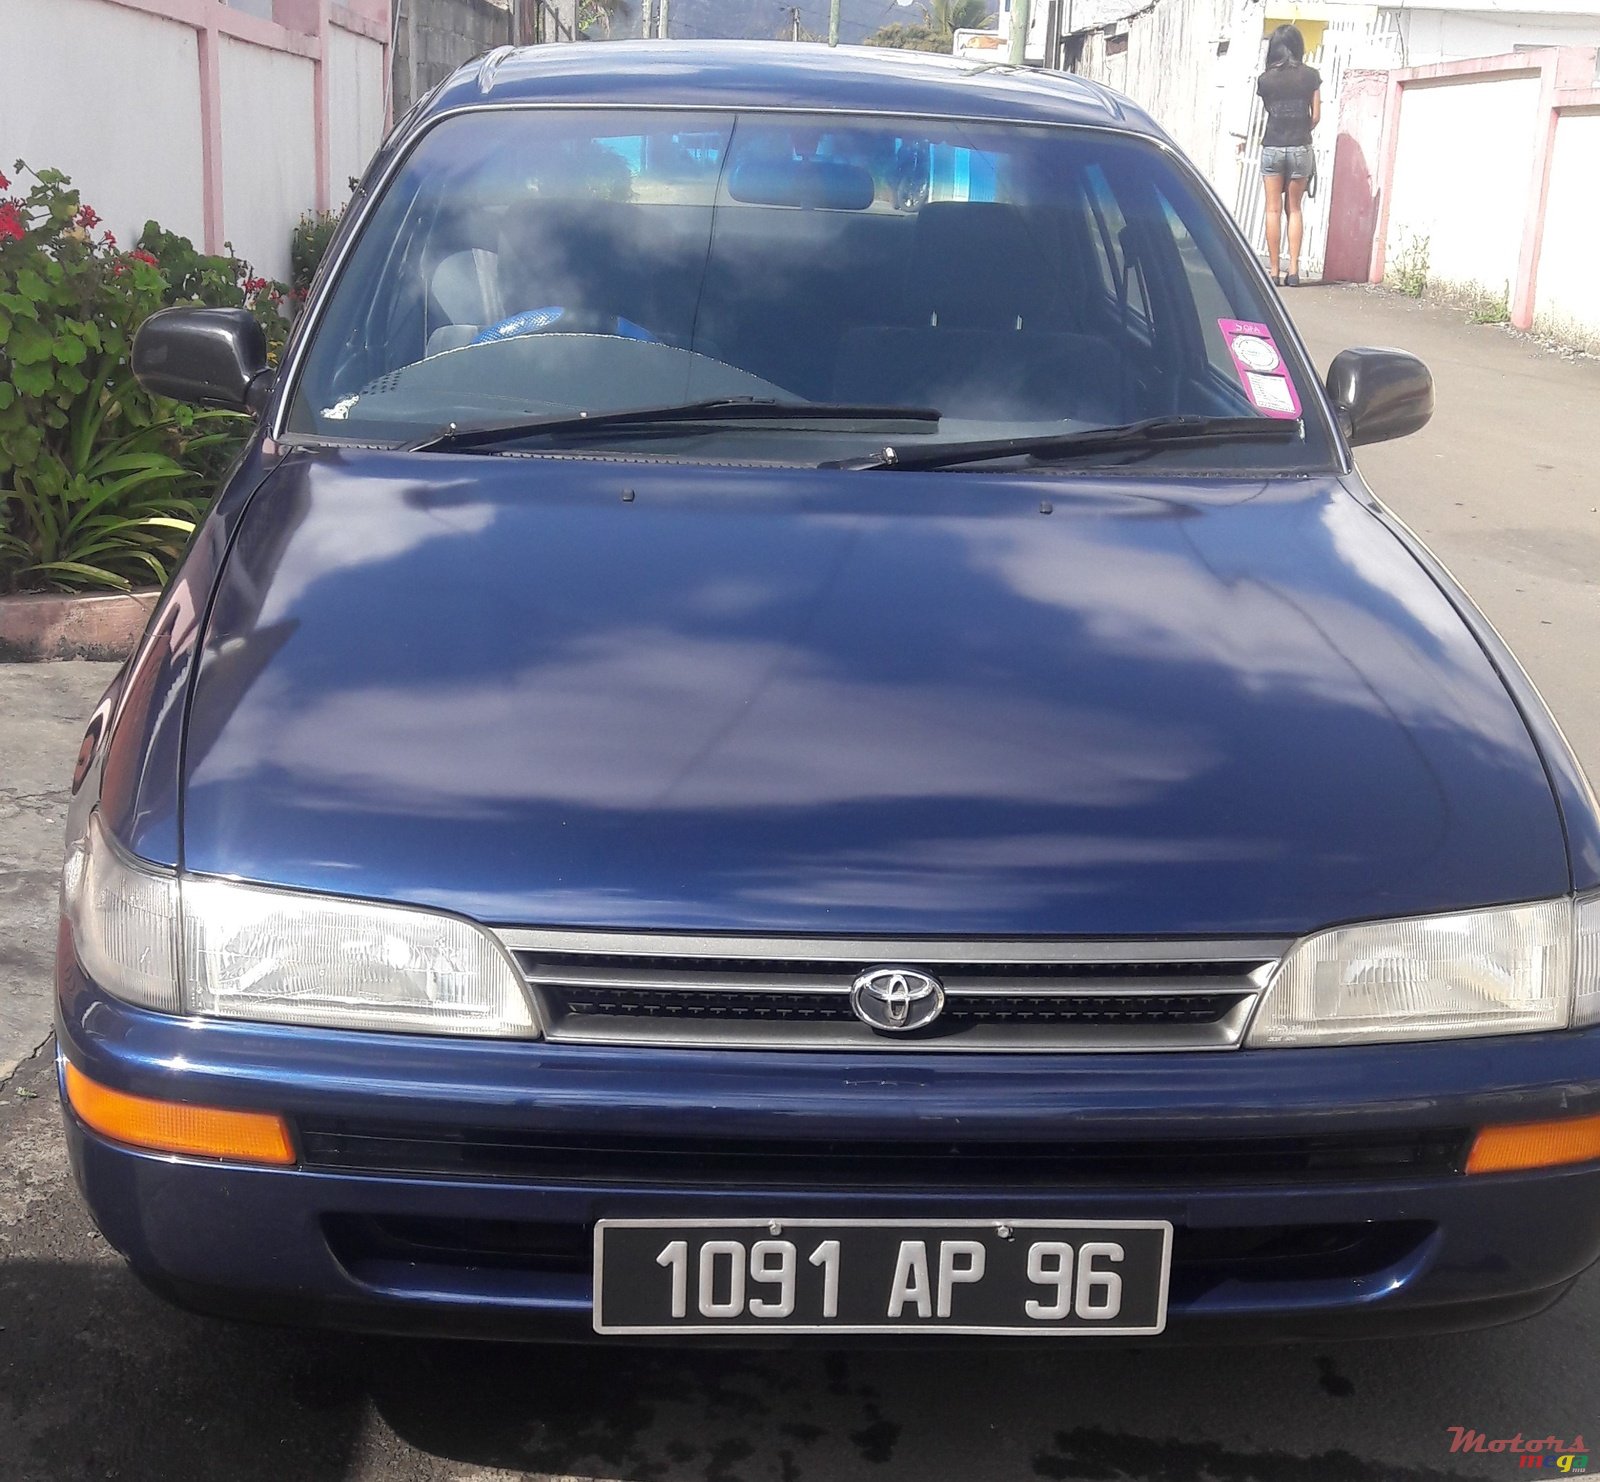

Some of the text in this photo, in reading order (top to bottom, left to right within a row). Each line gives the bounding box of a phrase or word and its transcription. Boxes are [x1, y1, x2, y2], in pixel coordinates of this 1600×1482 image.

[656, 1240, 1124, 1320] 1091 AP 96
